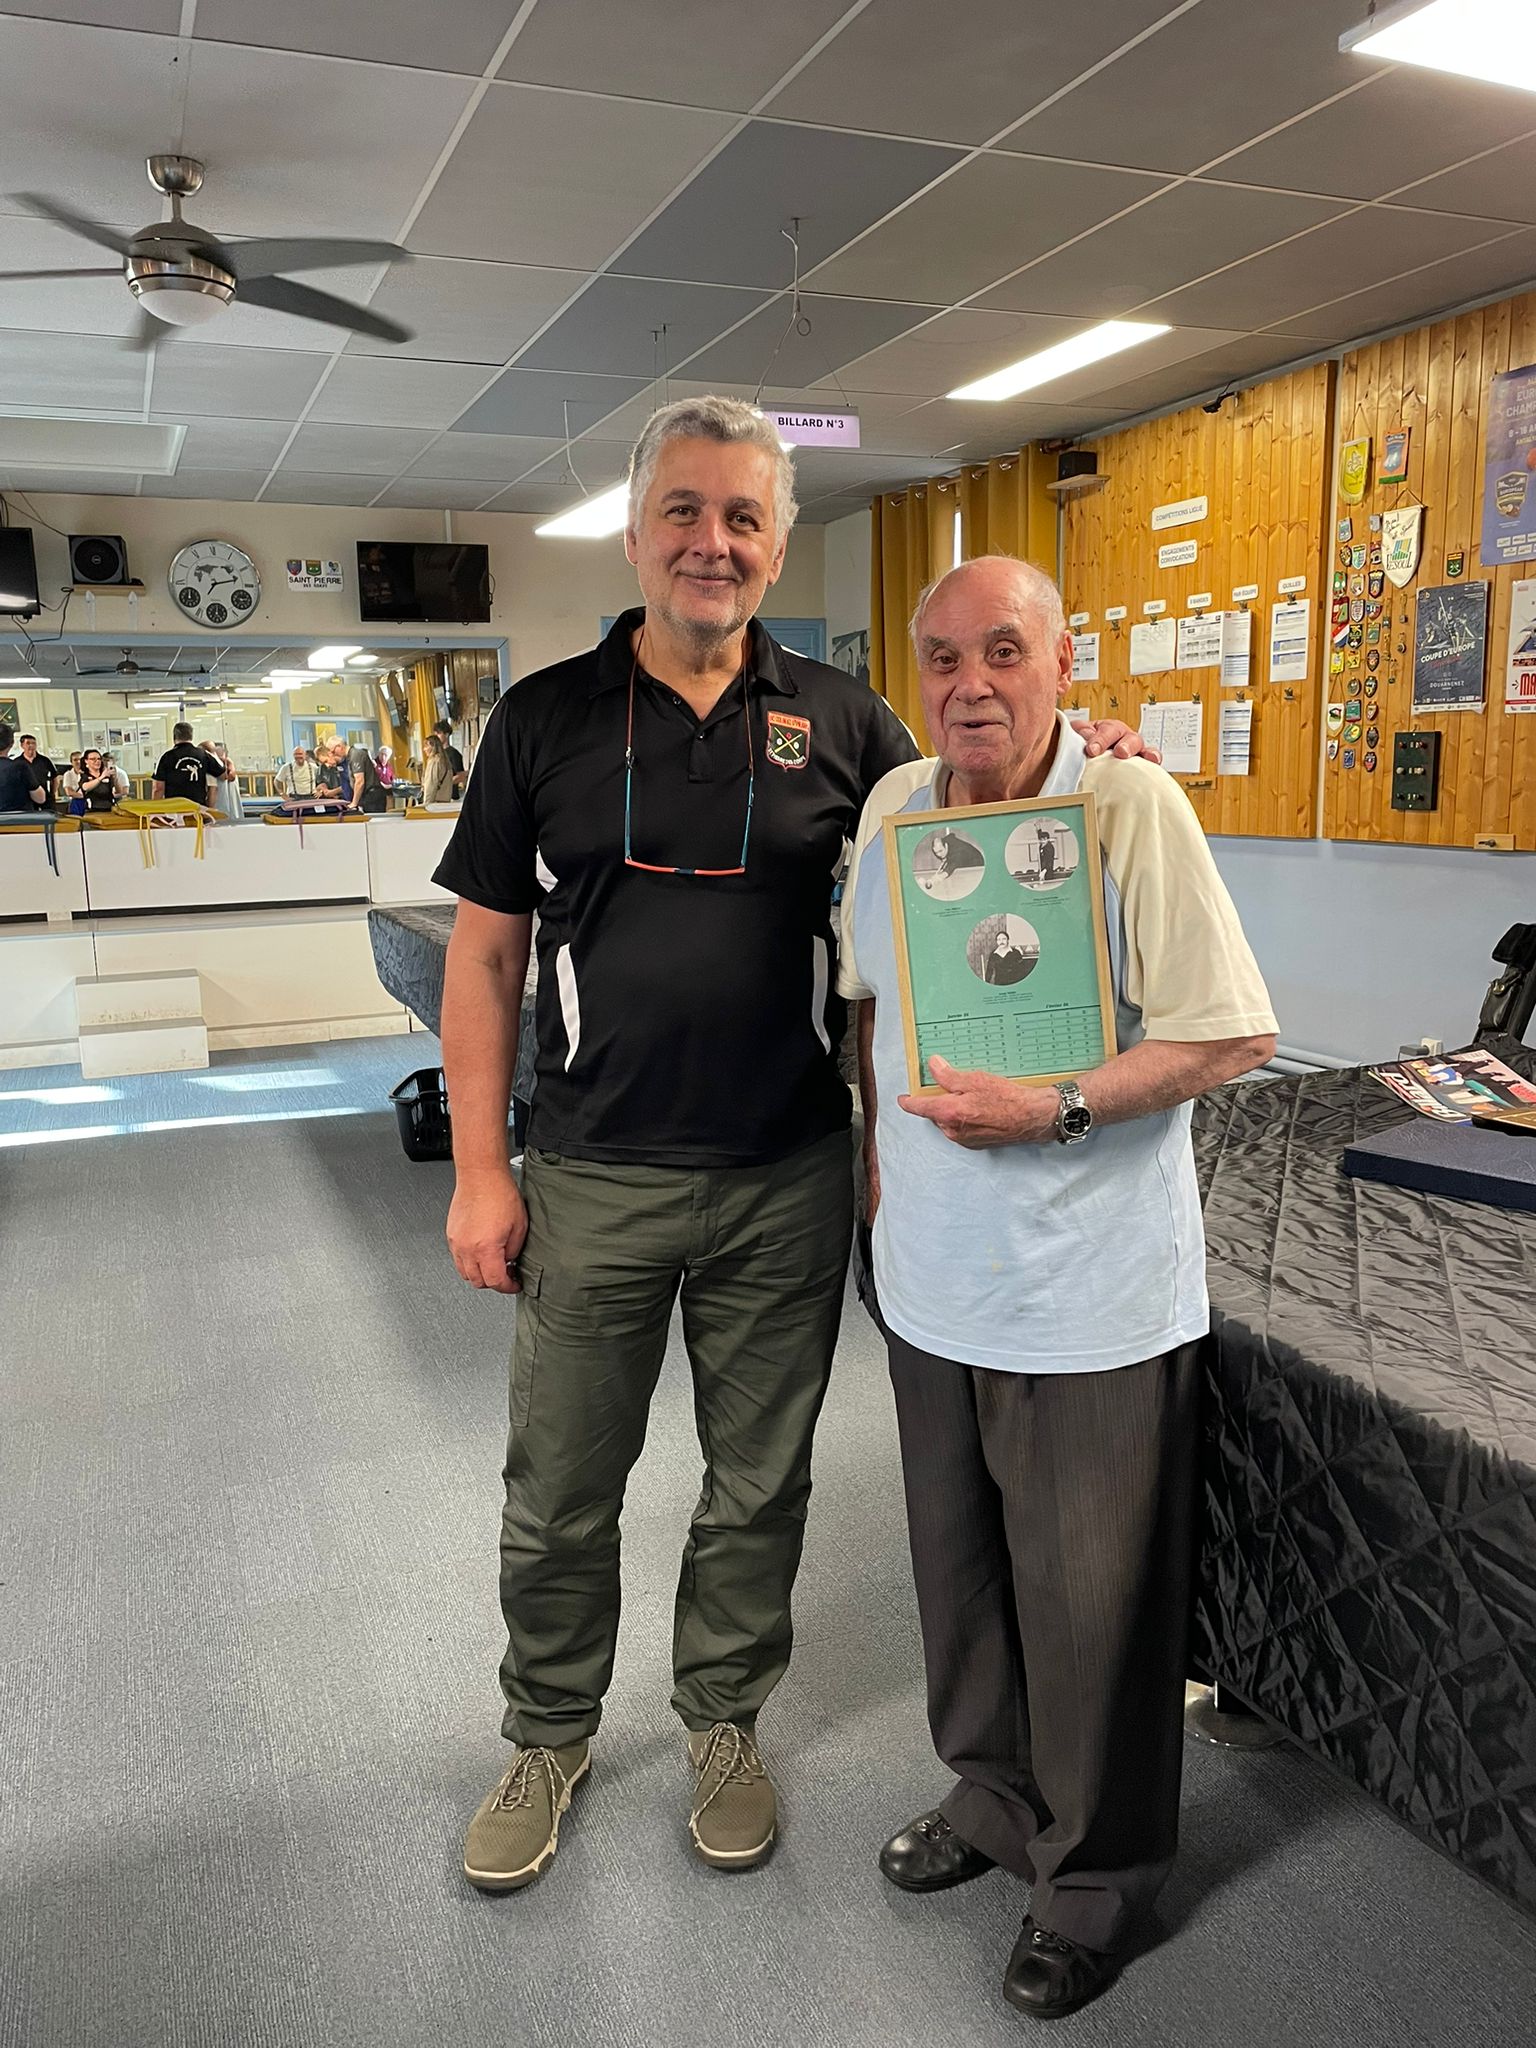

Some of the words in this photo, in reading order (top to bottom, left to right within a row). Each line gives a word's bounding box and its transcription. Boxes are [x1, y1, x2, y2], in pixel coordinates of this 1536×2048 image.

[778, 417, 823, 428] BILLARD
[1161, 544, 1195, 556] ENGAGEMENTS
[1161, 552, 1195, 564] CONVOCATIONS
[289, 576, 311, 584] SAINT
[314, 576, 342, 584] PIERRE
[1420, 650, 1443, 663] COUPE
[1443, 641, 1476, 657] D'EUROPE
